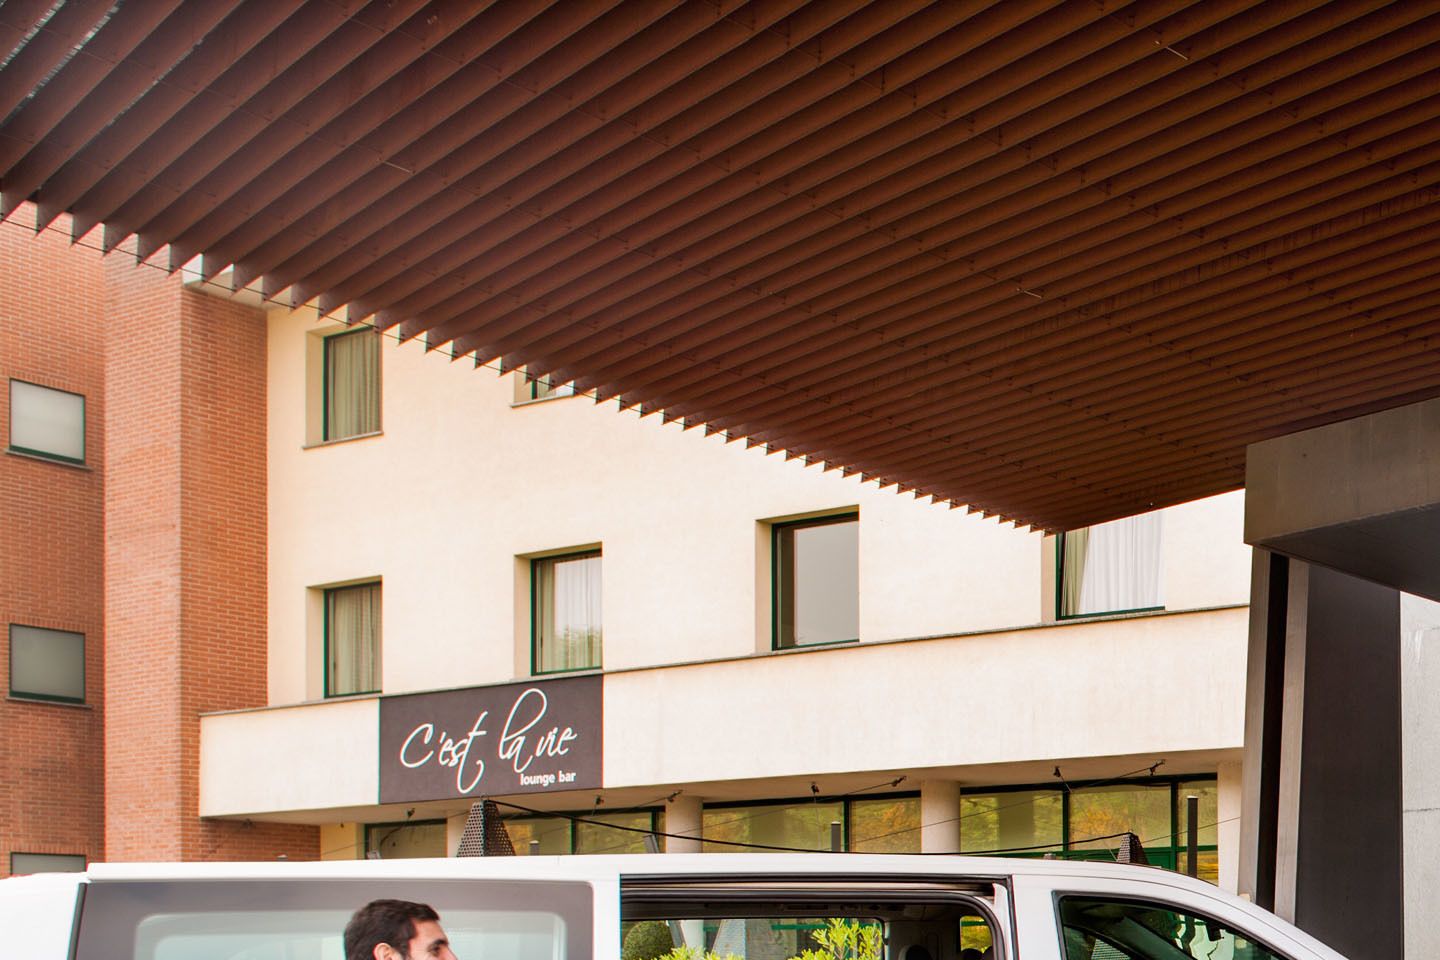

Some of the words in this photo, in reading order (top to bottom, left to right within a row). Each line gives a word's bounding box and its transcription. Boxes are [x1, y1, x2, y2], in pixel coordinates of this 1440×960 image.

[499, 688, 548, 773] la
[536, 726, 578, 757] vie
[520, 773, 556, 787] lounge
[558, 770, 577, 783] bar
